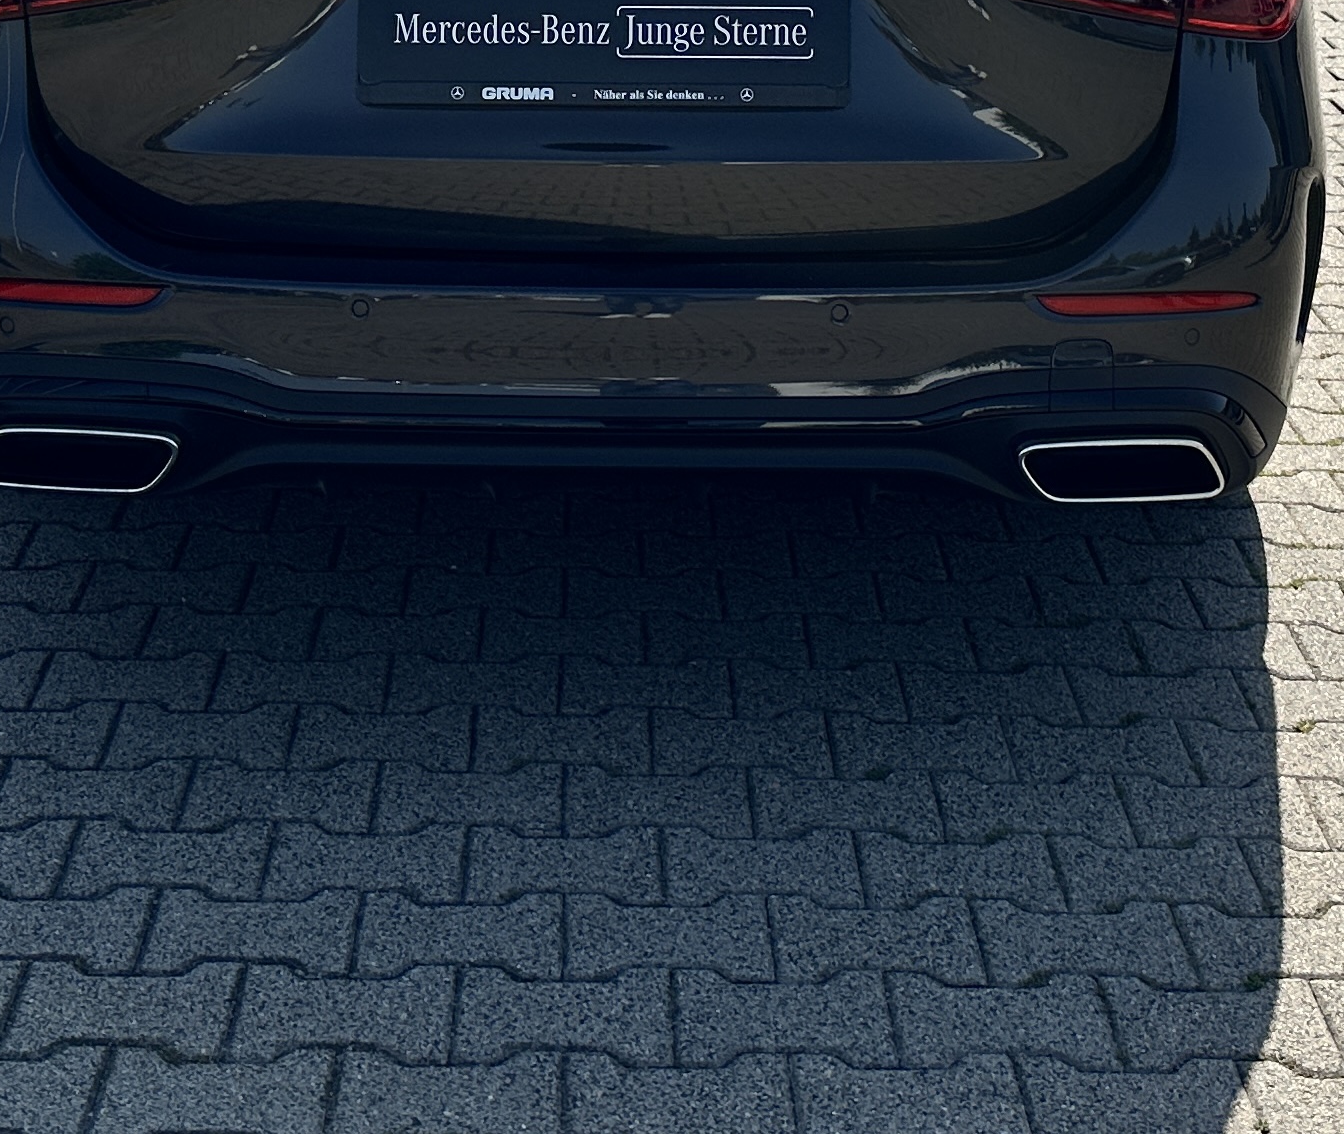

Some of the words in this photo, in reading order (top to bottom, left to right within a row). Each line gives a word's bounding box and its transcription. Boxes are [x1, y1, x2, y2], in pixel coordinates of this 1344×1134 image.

[394, 13, 610, 44] Mercedes-Benz
[624, 14, 705, 52] Junge
[713, 14, 807, 46] Sterne
[481, 86, 554, 100] GRUMA
[593, 89, 627, 100] Näher
[629, 89, 645, 100] als
[646, 89, 663, 100] Sie
[665, 89, 705, 100] denken
